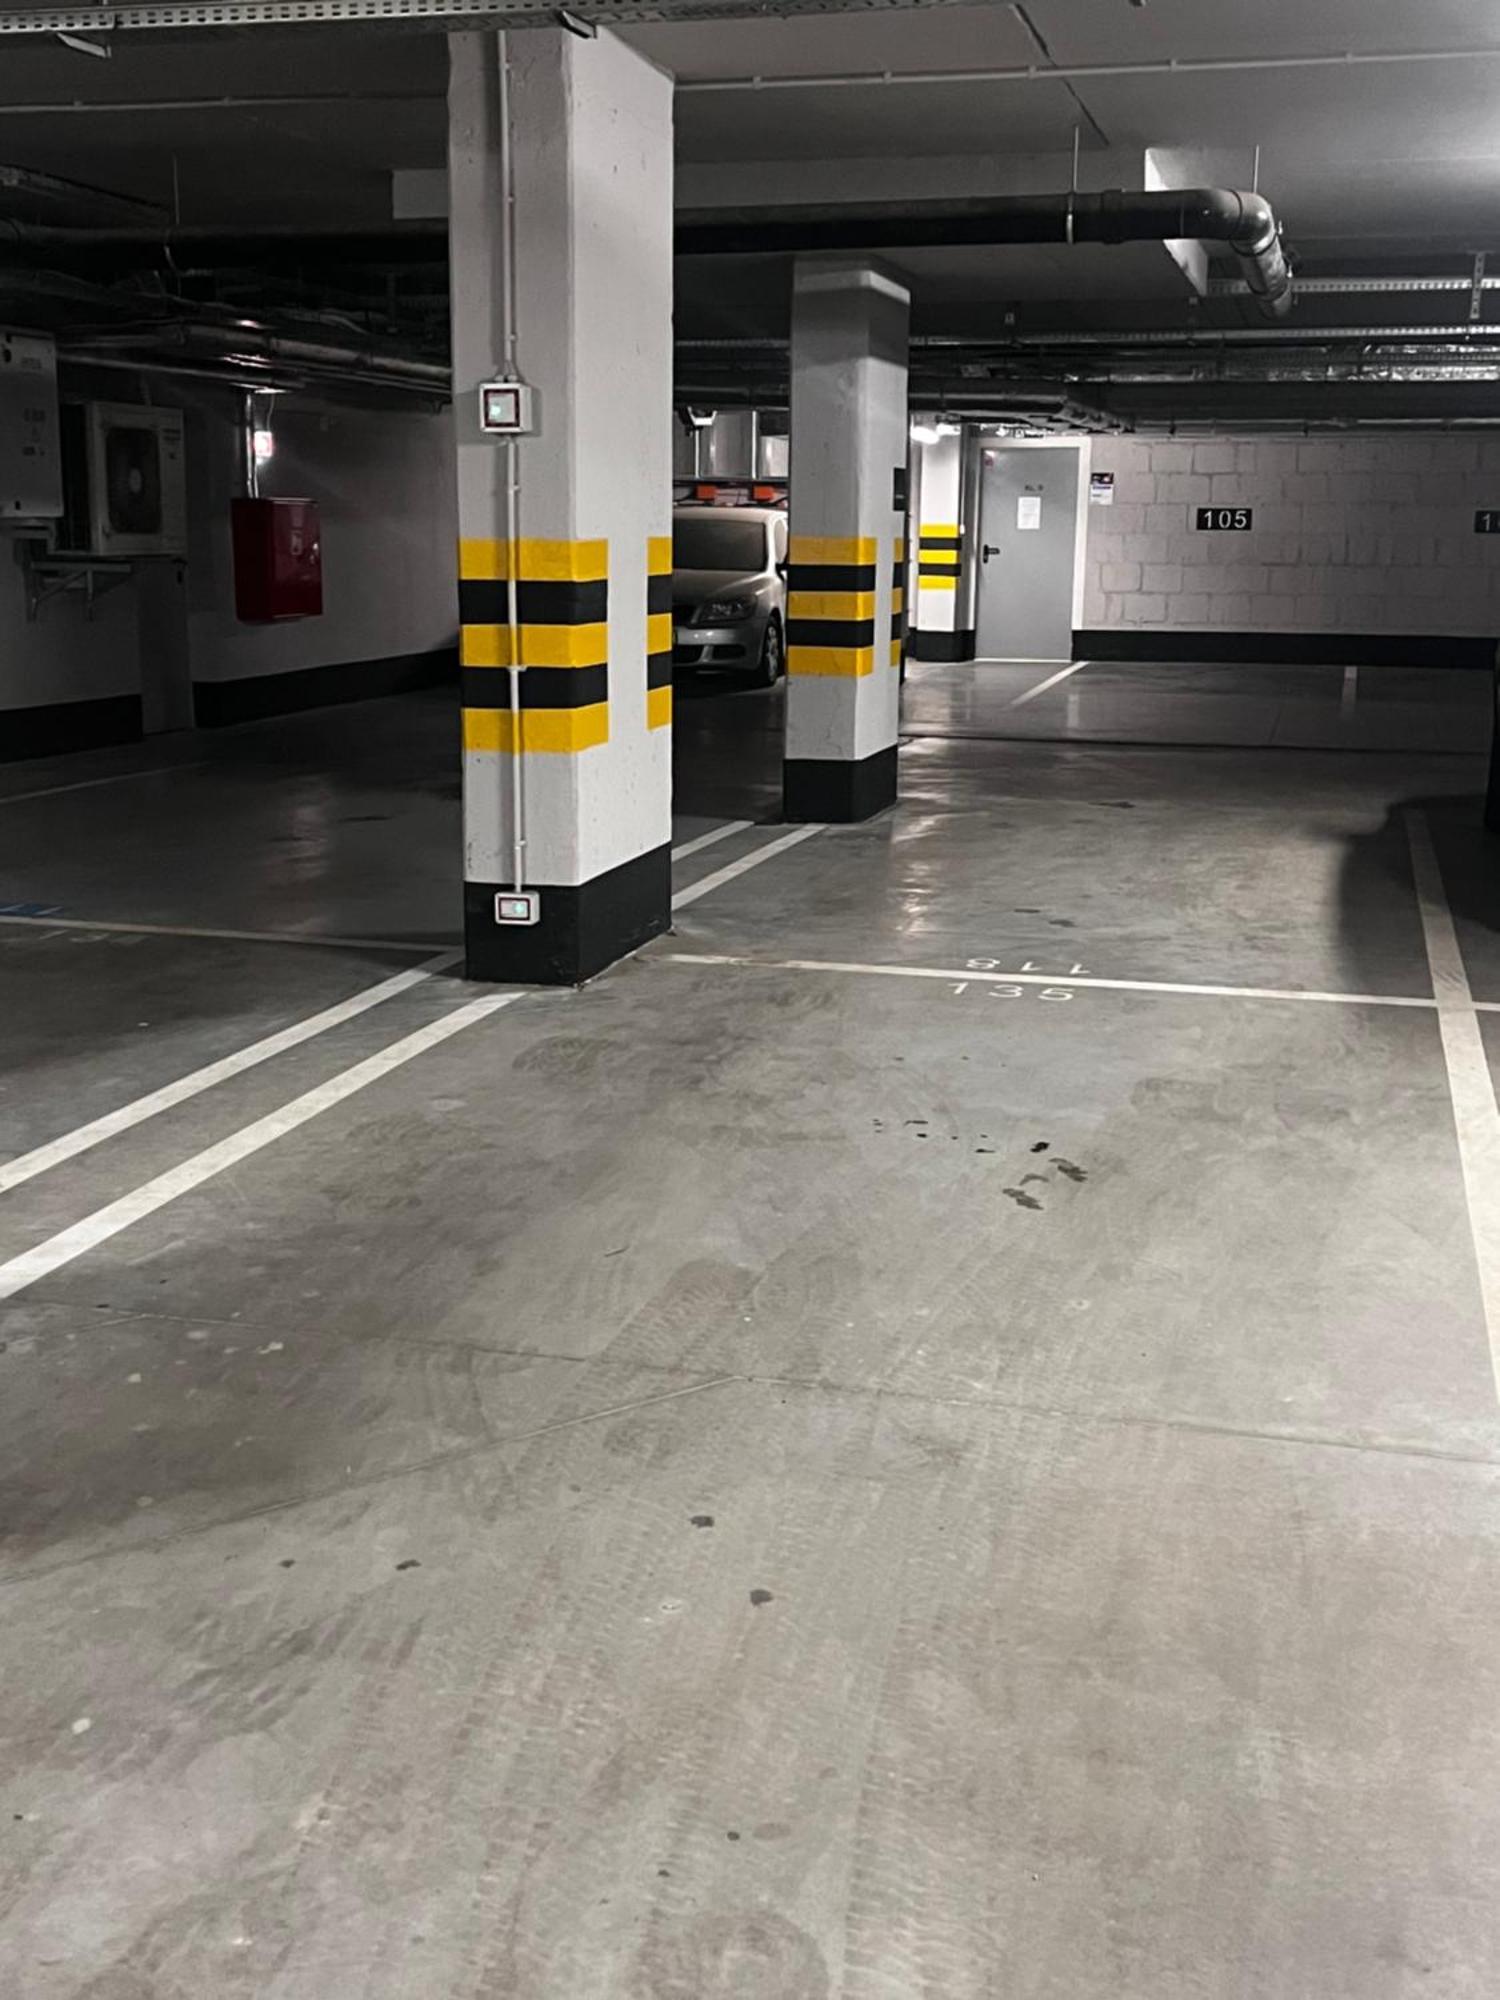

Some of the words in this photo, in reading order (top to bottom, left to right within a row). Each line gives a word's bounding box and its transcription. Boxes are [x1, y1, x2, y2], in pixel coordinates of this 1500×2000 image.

[1204, 510, 1247, 529] 105
[1482, 513, 1500, 531] 1
[966, 958, 1090, 974] 118
[949, 982, 1074, 1001] 135
